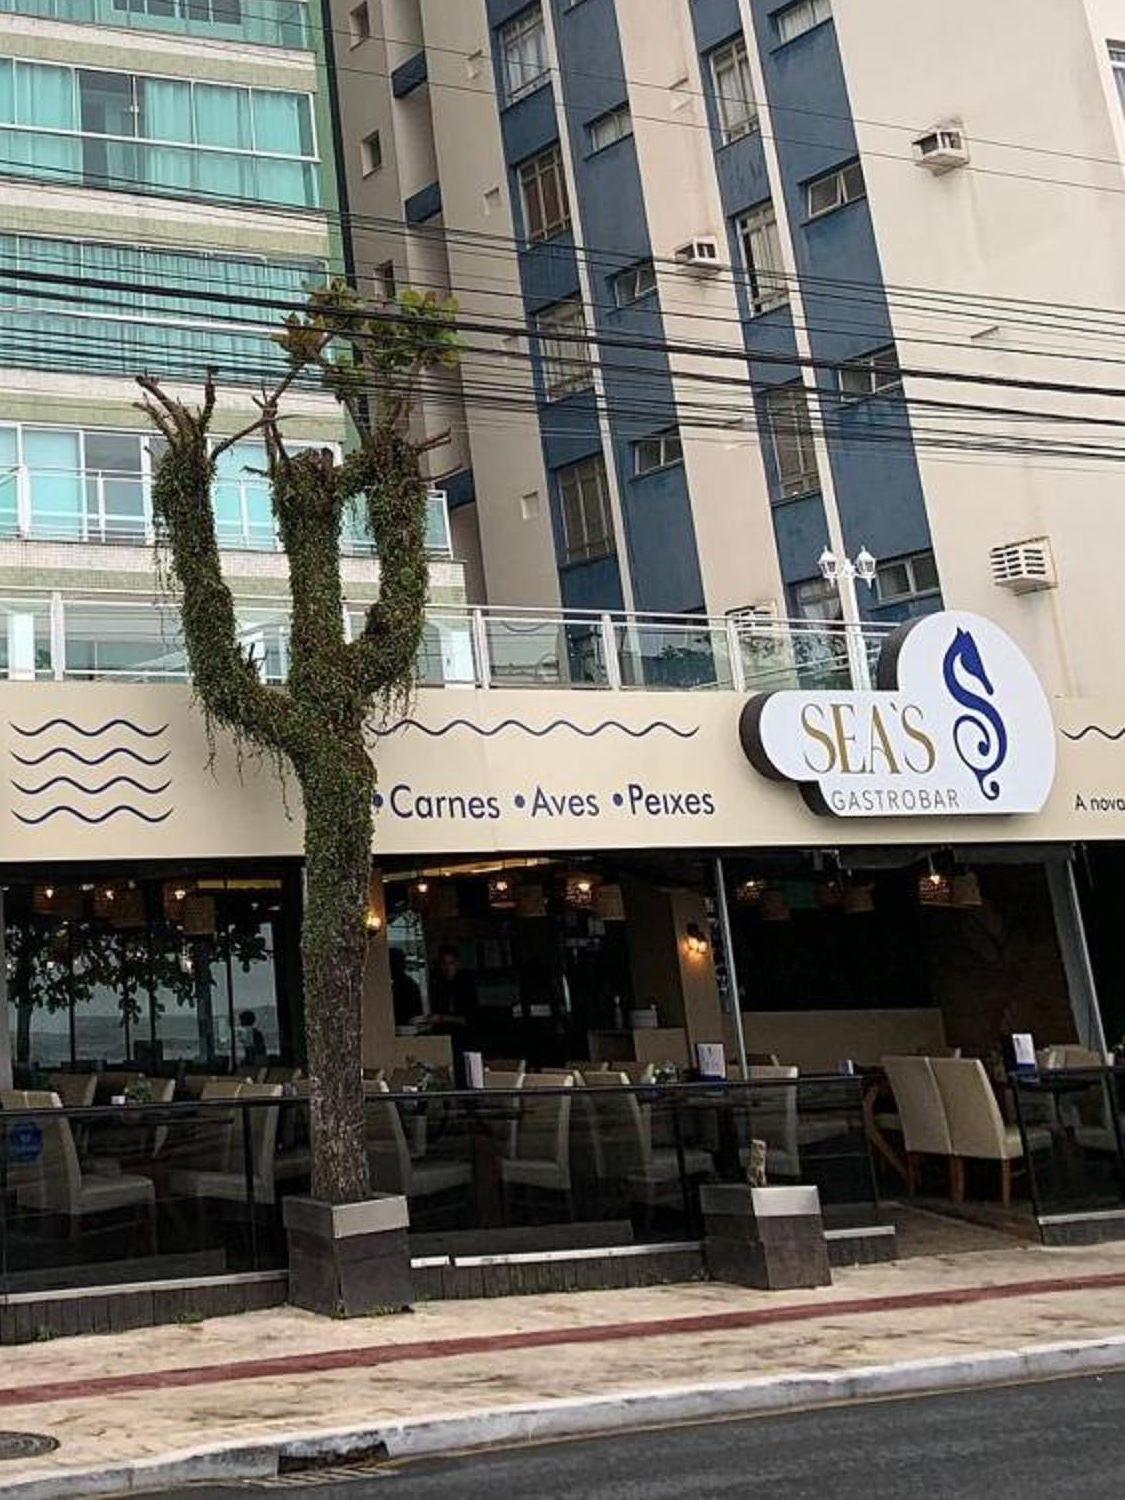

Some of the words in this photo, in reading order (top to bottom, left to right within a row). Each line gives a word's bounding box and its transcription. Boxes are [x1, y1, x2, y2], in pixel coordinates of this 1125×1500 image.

[800, 702, 936, 775] SEA'S
[831, 789, 960, 811] GASTROBAR
[1075, 794, 1087, 811] A
